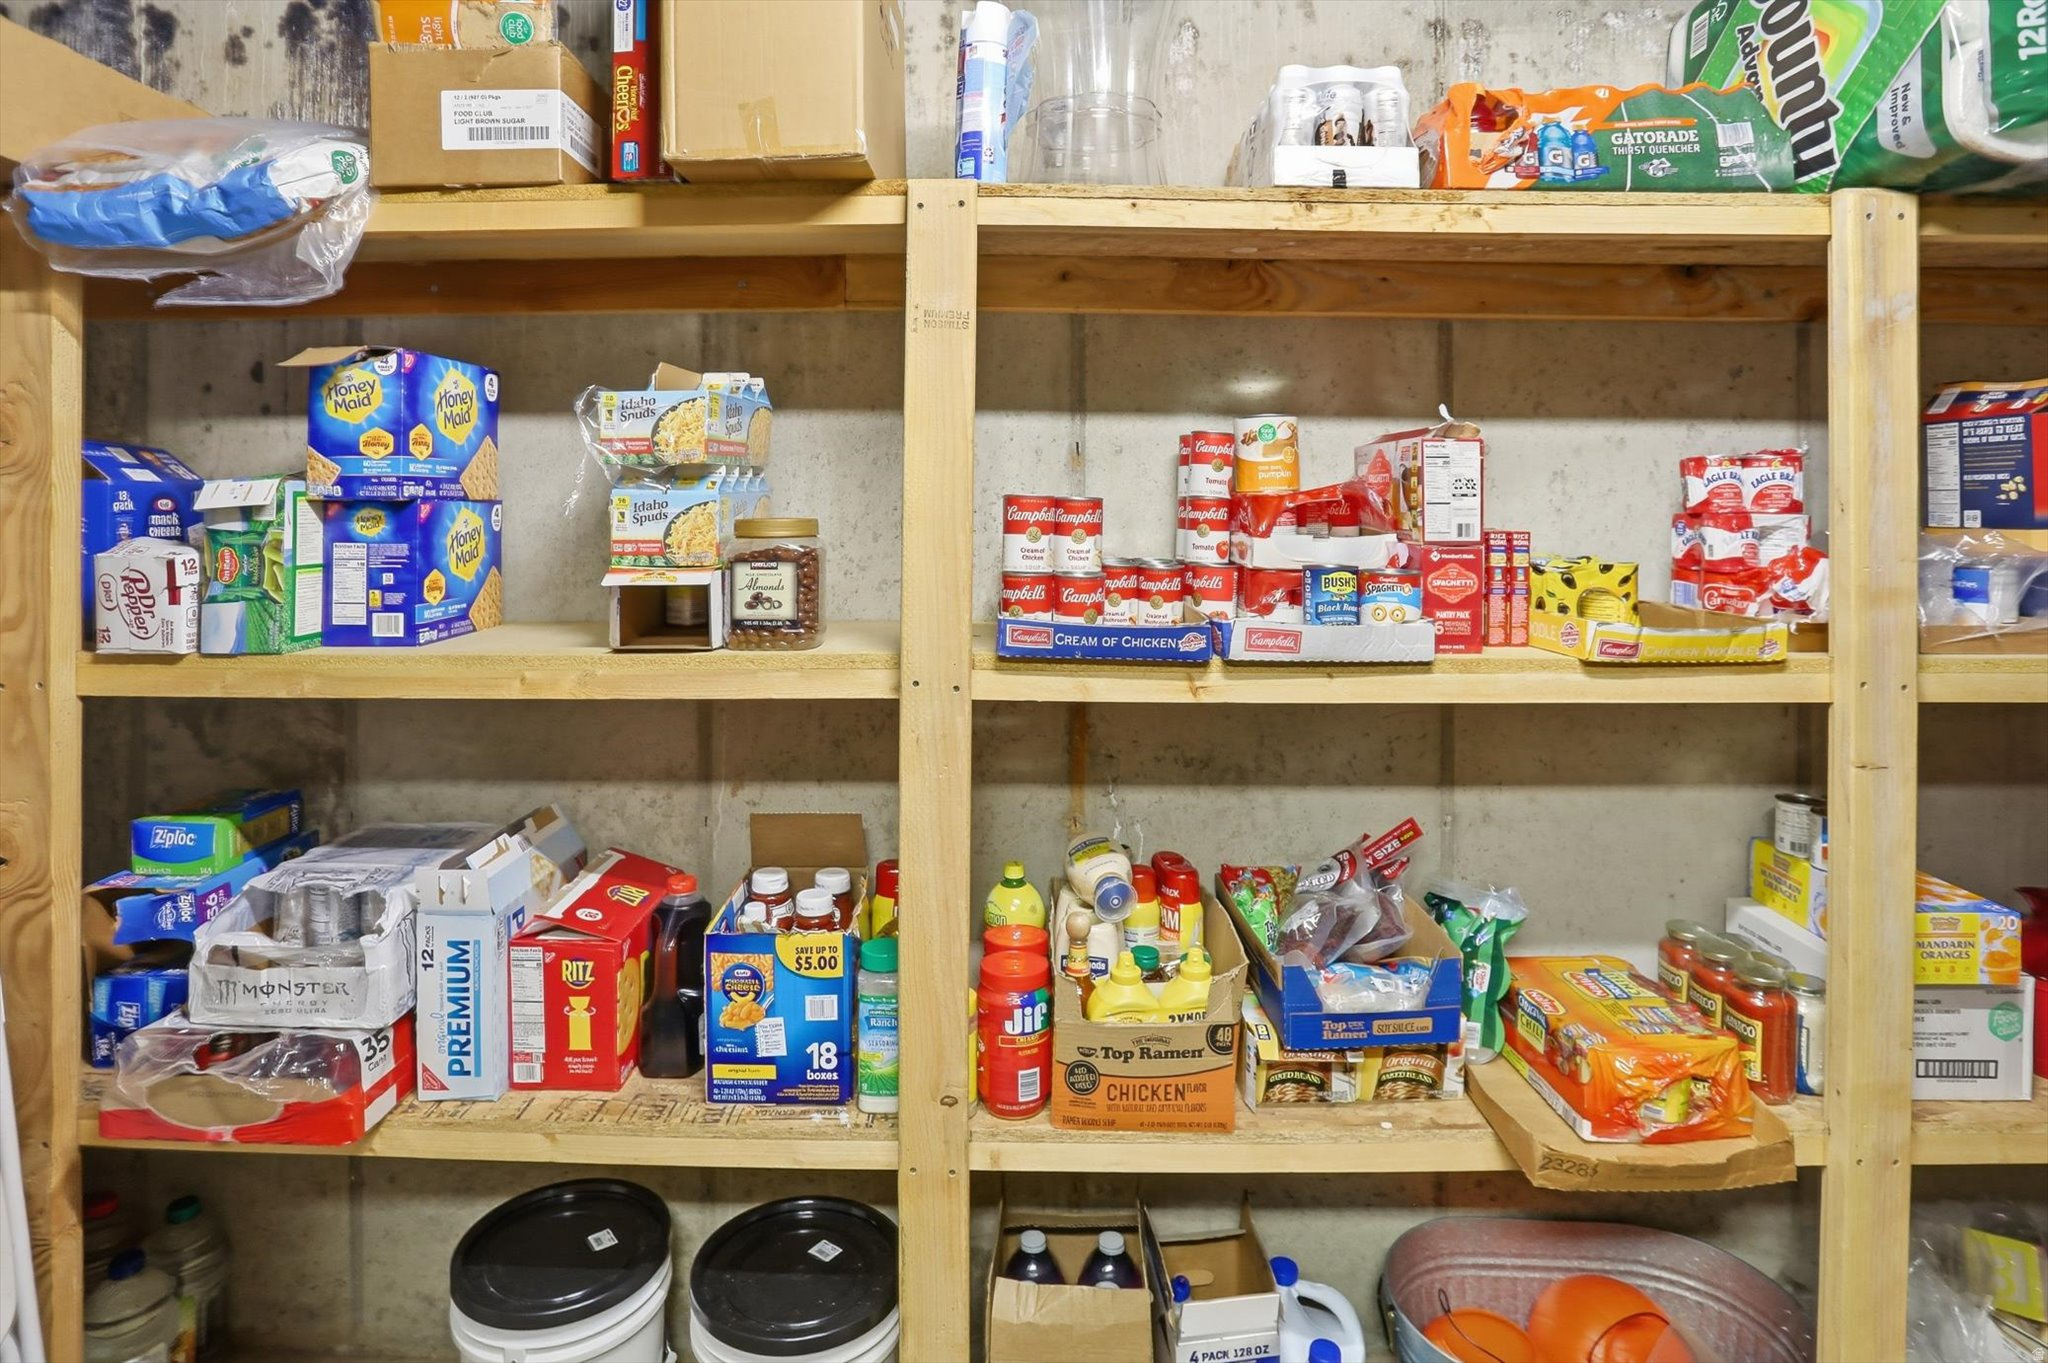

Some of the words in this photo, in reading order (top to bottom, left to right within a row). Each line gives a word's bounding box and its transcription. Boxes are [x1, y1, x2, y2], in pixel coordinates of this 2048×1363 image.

[1761, 0, 1841, 181] ounty
[1901, 82, 1911, 113] New
[1890, 87, 1908, 150] Improved
[1902, 116, 1911, 128] &
[1611, 130, 1699, 145] GATORADE
[1548, 150, 1563, 164] G
[1612, 145, 1647, 155] THIRST
[1650, 144, 1700, 154] QUENCHER
[1578, 156, 1589, 167] G
[326, 379, 376, 400] Honey
[334, 394, 372, 413] Maid
[437, 388, 474, 410] Honey
[621, 396, 656, 411] Idaho
[620, 407, 656, 422] Spuds
[725, 402, 742, 419] Idaho
[444, 409, 471, 429] Maid
[725, 418, 743, 438] Spuds
[1258, 470, 1292, 479] pumpkin
[633, 500, 669, 513] Idaho
[356, 514, 382, 524] Honey
[632, 511, 669, 526] Spuds
[360, 522, 380, 531] Maid
[450, 525, 482, 552] Honey
[1192, 543, 1214, 551] Tomato
[456, 546, 479, 569] Maid
[1022, 553, 1044, 561] Chicken
[1068, 554, 1090, 562] Chicken
[181, 558, 197, 572] 12
[738, 577, 784, 591] Almonds
[1324, 577, 1356, 588] BUSH'S
[101, 581, 114, 603] Diet
[120, 576, 150, 634] Pepper
[138, 594, 156, 619] Dr
[1318, 604, 1341, 612] Black
[98, 626, 111, 644] 12
[1435, 621, 1444, 635] 6
[1011, 630, 1049, 643] Campbell's
[1055, 633, 1098, 646] CREAM
[1102, 636, 1117, 647] OF
[1122, 636, 1177, 648] CHICKEN
[1251, 633, 1296, 647] Campbell's
[155, 829, 196, 848] Ziploc
[1374, 839, 1401, 860] SIZE
[616, 885, 650, 907] RITZ
[1998, 915, 2018, 930] 20
[828, 946, 837, 954] TO
[1916, 941, 1975, 949] MANDARIN
[422, 949, 434, 971] 12
[795, 956, 837, 970] $5.00
[1921, 951, 1970, 960] ORANGES
[562, 960, 595, 982] RITZ
[242, 980, 350, 998] MONSTER
[447, 940, 471, 1076] PREMIUM
[1005, 1004, 1048, 1035] Jif
[1322, 1021, 1347, 1031] Top
[430, 1012, 446, 1054] original
[1322, 1030, 1367, 1040] Ramen
[361, 1028, 390, 1062] 35
[806, 1042, 838, 1070] 18
[1100, 1047, 1134, 1063] Top
[1140, 1047, 1204, 1059] Ramen
[1386, 1054, 1436, 1068] Original
[807, 1070, 838, 1080] boxes
[1107, 1084, 1185, 1101] CHICKEN
[1187, 1083, 1207, 1093] FLAVOR
[1190, 1351, 1199, 1363] 4
[1202, 1350, 1230, 1362] PACK
[1234, 1347, 1252, 1358] 128
[1255, 1345, 1269, 1355] OZ
